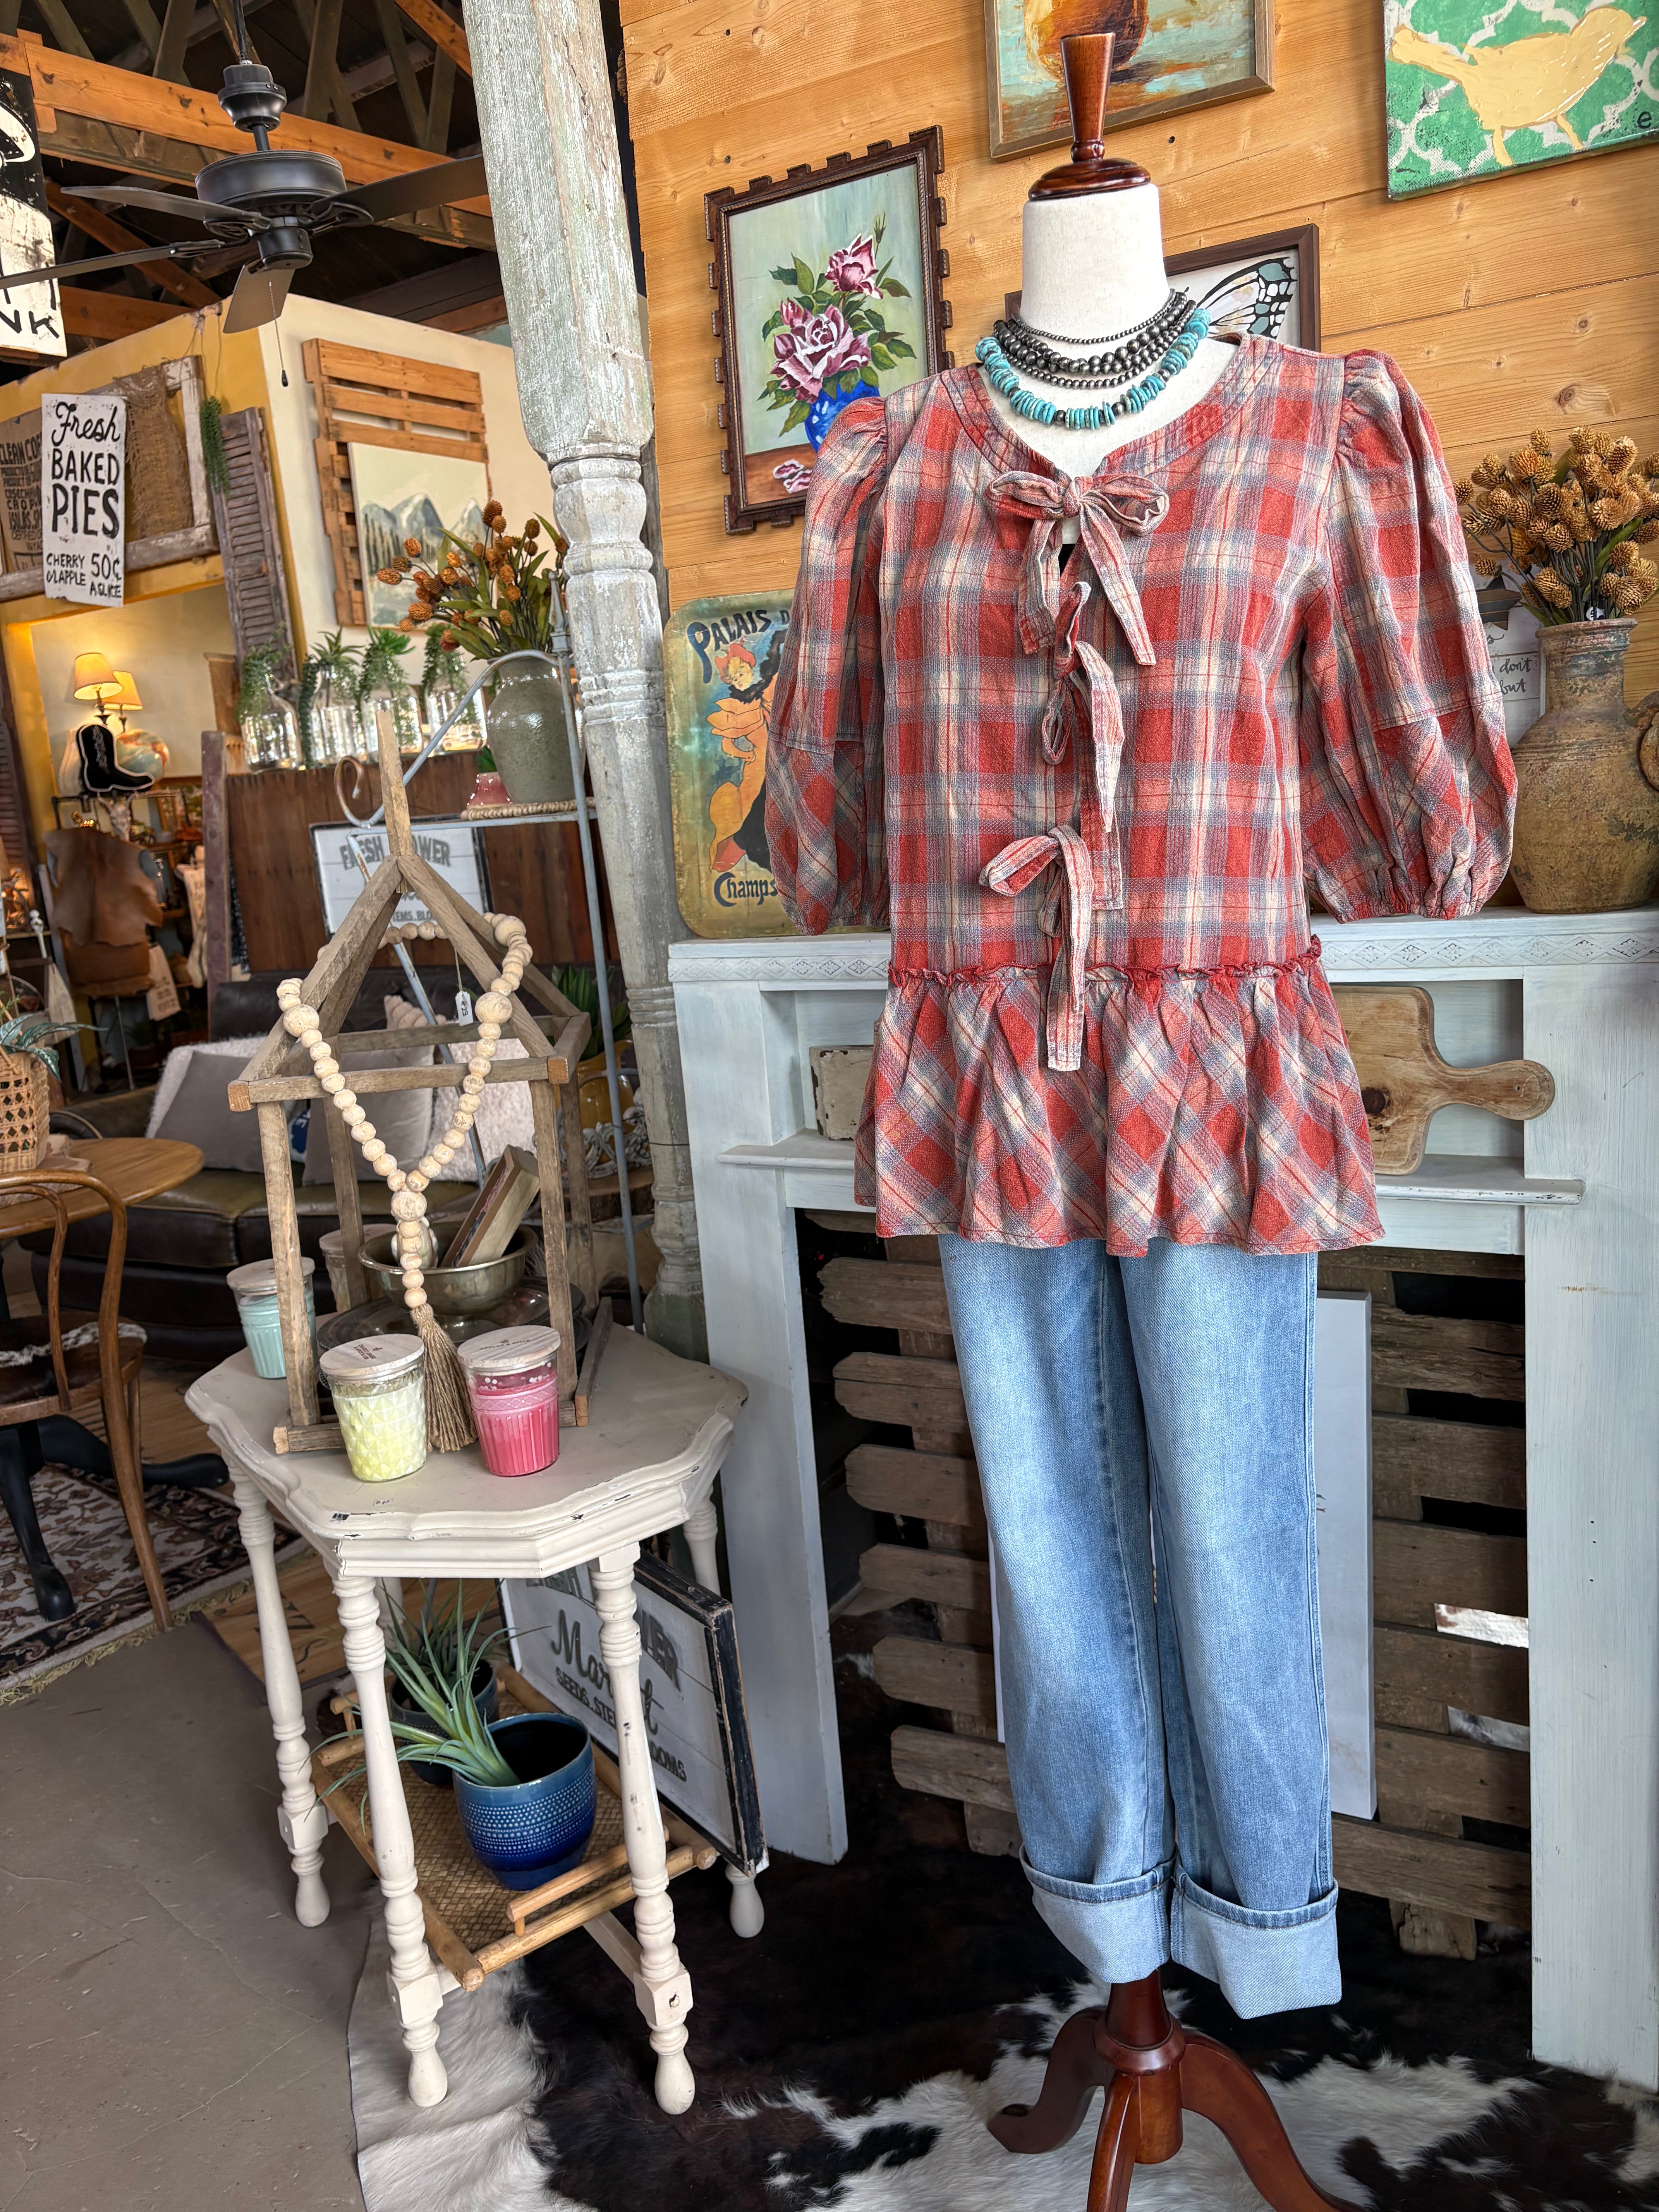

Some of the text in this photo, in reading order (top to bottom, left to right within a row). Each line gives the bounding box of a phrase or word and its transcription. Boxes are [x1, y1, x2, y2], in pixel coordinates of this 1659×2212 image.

[52, 402, 120, 447] Fresh
[52, 448, 120, 486] BAKED
[52, 483, 119, 539] PIES
[46, 553, 85, 569] CHERRY
[58, 570, 86, 586] APPLE
[90, 581, 97, 596] A
[1499, 678, 1527, 695] but
[714, 872, 778, 907] Champs
[551, 1609, 664, 1735] Mart
